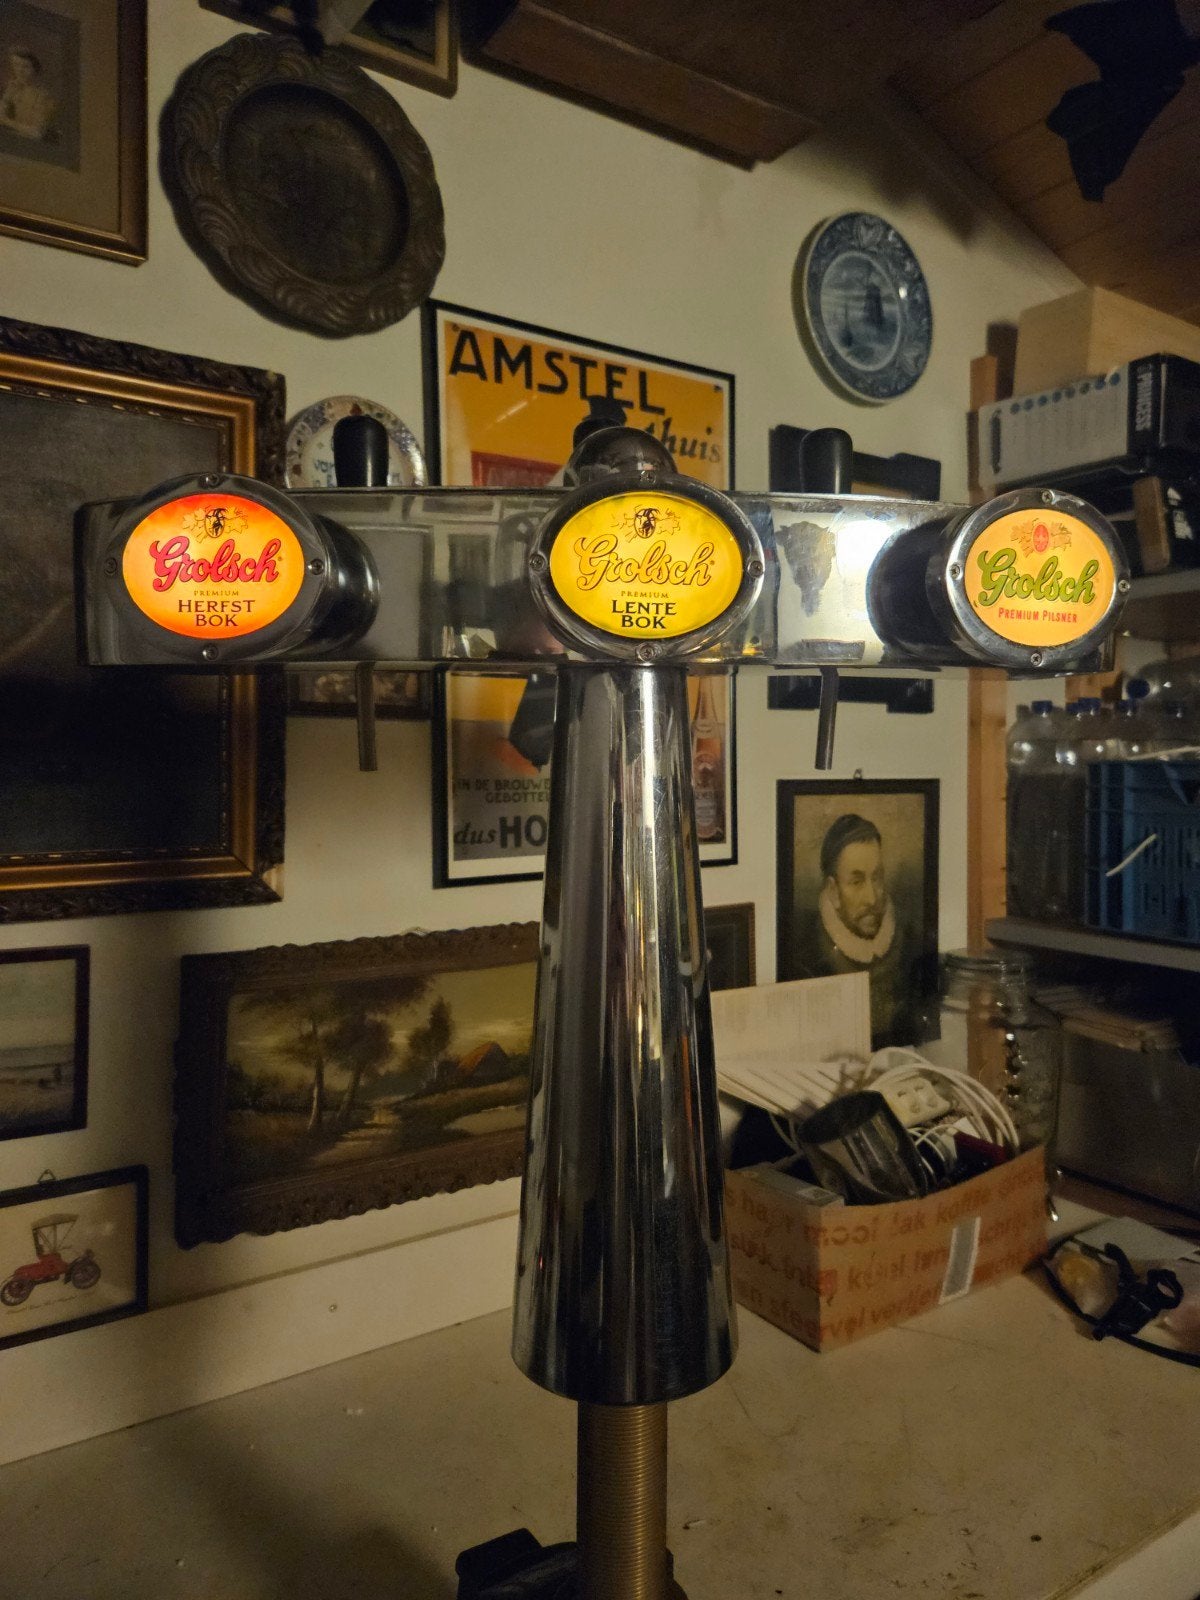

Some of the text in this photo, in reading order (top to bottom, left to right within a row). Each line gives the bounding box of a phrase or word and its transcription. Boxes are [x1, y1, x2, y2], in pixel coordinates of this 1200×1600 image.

[449, 330, 665, 416] AMSTEL
[149, 535, 282, 593] Grolsch
[573, 533, 715, 592] Grolsch
[977, 548, 1100, 607] Grolsch
[621, 590, 669, 599] PREMIUM
[178, 599, 256, 613] HERFST
[611, 599, 677, 615] LENTE
[195, 613, 239, 627] BOK
[621, 615, 667, 629] BOK
[998, 606, 1078, 624] PREMIUM PILSNER
